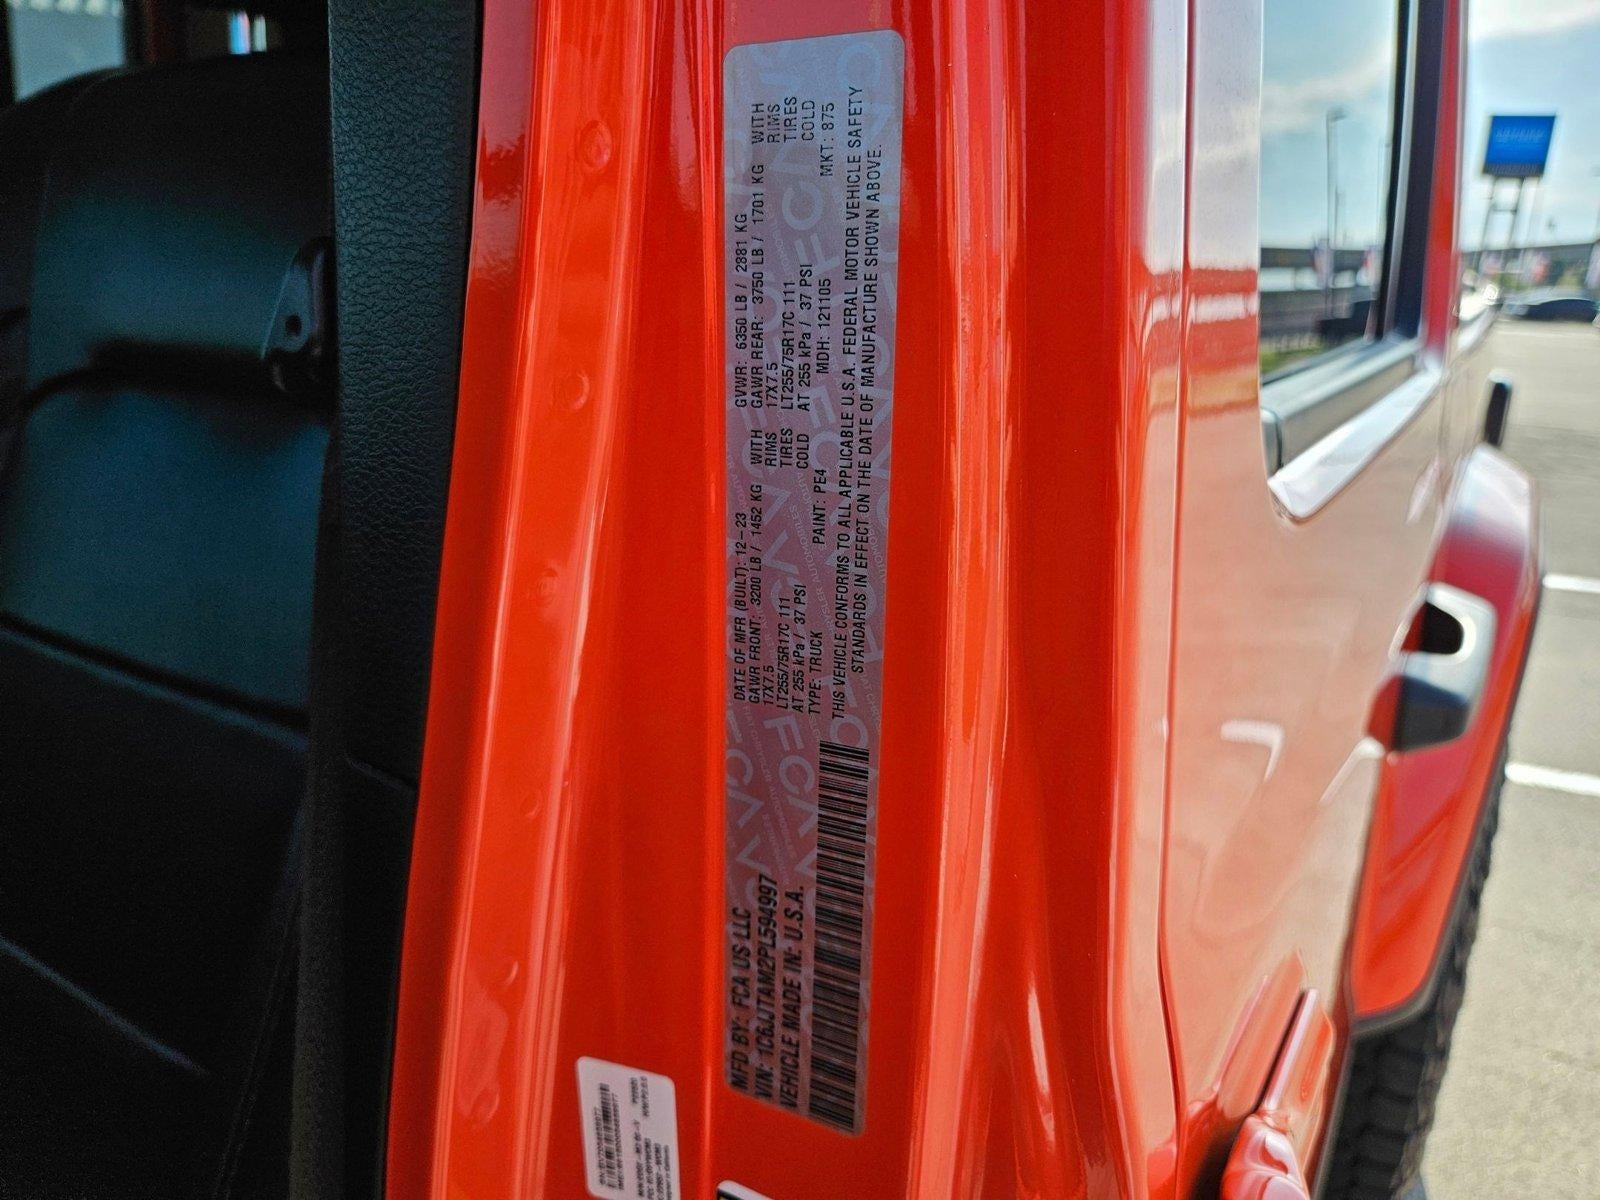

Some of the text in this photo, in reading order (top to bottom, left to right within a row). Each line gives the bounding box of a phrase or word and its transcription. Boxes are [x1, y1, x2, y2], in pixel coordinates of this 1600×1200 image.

[752, 103, 764, 144] WITH
[768, 104, 780, 143] RIMS
[784, 97, 797, 142] TIRES
[802, 100, 814, 141] COLD
[821, 102, 834, 177] MKT: 875
[752, 165, 764, 184] KG
[735, 214, 747, 232] KG
[752, 193, 764, 223] 1701
[736, 241, 747, 272] 2881
[752, 248, 764, 264] LB
[752, 272, 763, 304] 3750
[801, 264, 812, 286] PSI
[736, 295, 747, 311] LB
[800, 294, 812, 310] 37
[736, 318, 747, 350] 6350
[751, 316, 763, 360] REAR:
[818, 278, 830, 374] MDH: 121105
[782, 282, 795, 410] LT255/75R17C 111
[798, 333, 811, 358] kPa
[735, 362, 747, 408] GVWR:
[751, 366, 763, 408] GAWR
[766, 362, 778, 408] 17X7.5
[798, 363, 810, 388] 255
[798, 394, 810, 412] AT
[832, 86, 863, 720] THIS VEHICLE CONFORMS TO ALL APPLICABLE U.S.A. FEDERAL MOTOR VEHICLE SAFETY
[852, 144, 882, 673] STANDARDS IN EFFECT ON THE DATE OF MANUFACTURE SHOWN ABOVE.
[750, 430, 762, 464] WITH
[765, 432, 777, 466] RIMS
[780, 428, 792, 468] TIRES
[796, 434, 809, 469] COLD
[750, 484, 762, 501] KG
[814, 468, 826, 544] PAINT: PE4
[750, 507, 762, 536] 1452
[750, 556, 762, 571] LB
[734, 562, 748, 611] (BUILT):
[750, 577, 761, 606] 3200
[794, 584, 806, 605] PSI
[734, 616, 746, 644] MFR
[794, 610, 805, 624] 37
[750, 614, 762, 660] FRONT:
[777, 598, 790, 709] LT255/75R17C 111
[734, 648, 746, 664] OF
[793, 644, 805, 666] kPa
[734, 669, 746, 700] DATE
[749, 665, 760, 704] GAWR
[762, 666, 774, 706] 17X7.5
[792, 670, 804, 692] 255
[808, 631, 822, 714] TYPE: TRUCK
[792, 698, 804, 713] AT
[730, 907, 750, 1090] MFD BY: FCA US LLC
[754, 874, 778, 1098] VIN: 1C6JJTAM2PL594997
[780, 886, 804, 1108] VEHICLE MADE IN: U.S.A.
